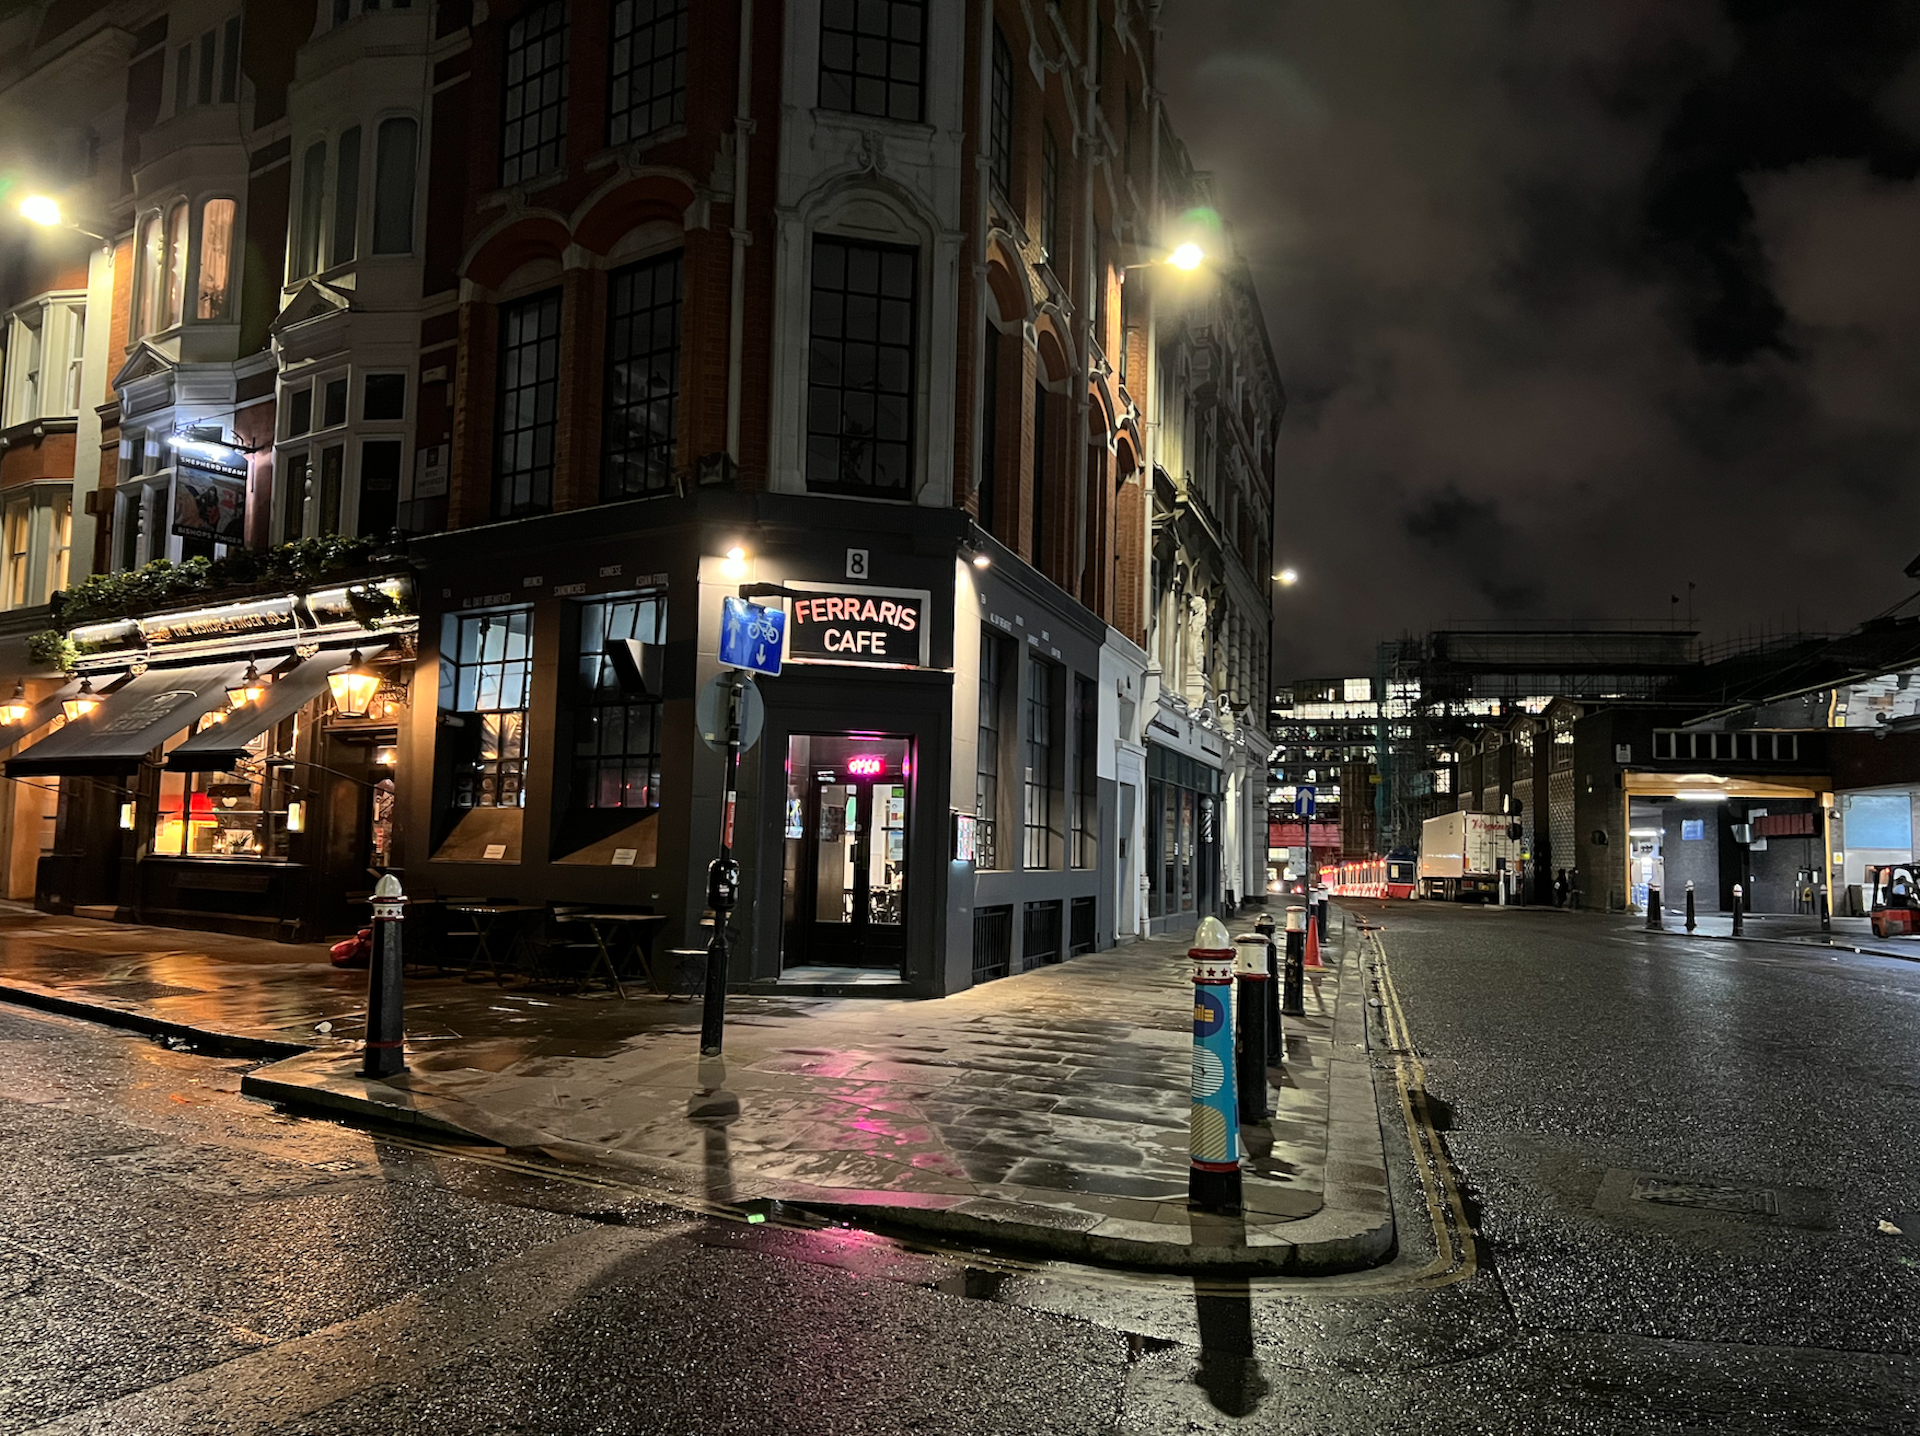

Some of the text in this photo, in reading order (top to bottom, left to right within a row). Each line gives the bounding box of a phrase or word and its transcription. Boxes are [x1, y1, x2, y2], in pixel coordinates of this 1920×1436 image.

[177, 526, 242, 545] BISHOPS FINGER
[851, 553, 864, 574] 8
[794, 597, 917, 631] FERRARIS
[170, 622, 192, 637] THE
[823, 628, 888, 655] CAFE
[848, 758, 880, 774] OPEN
